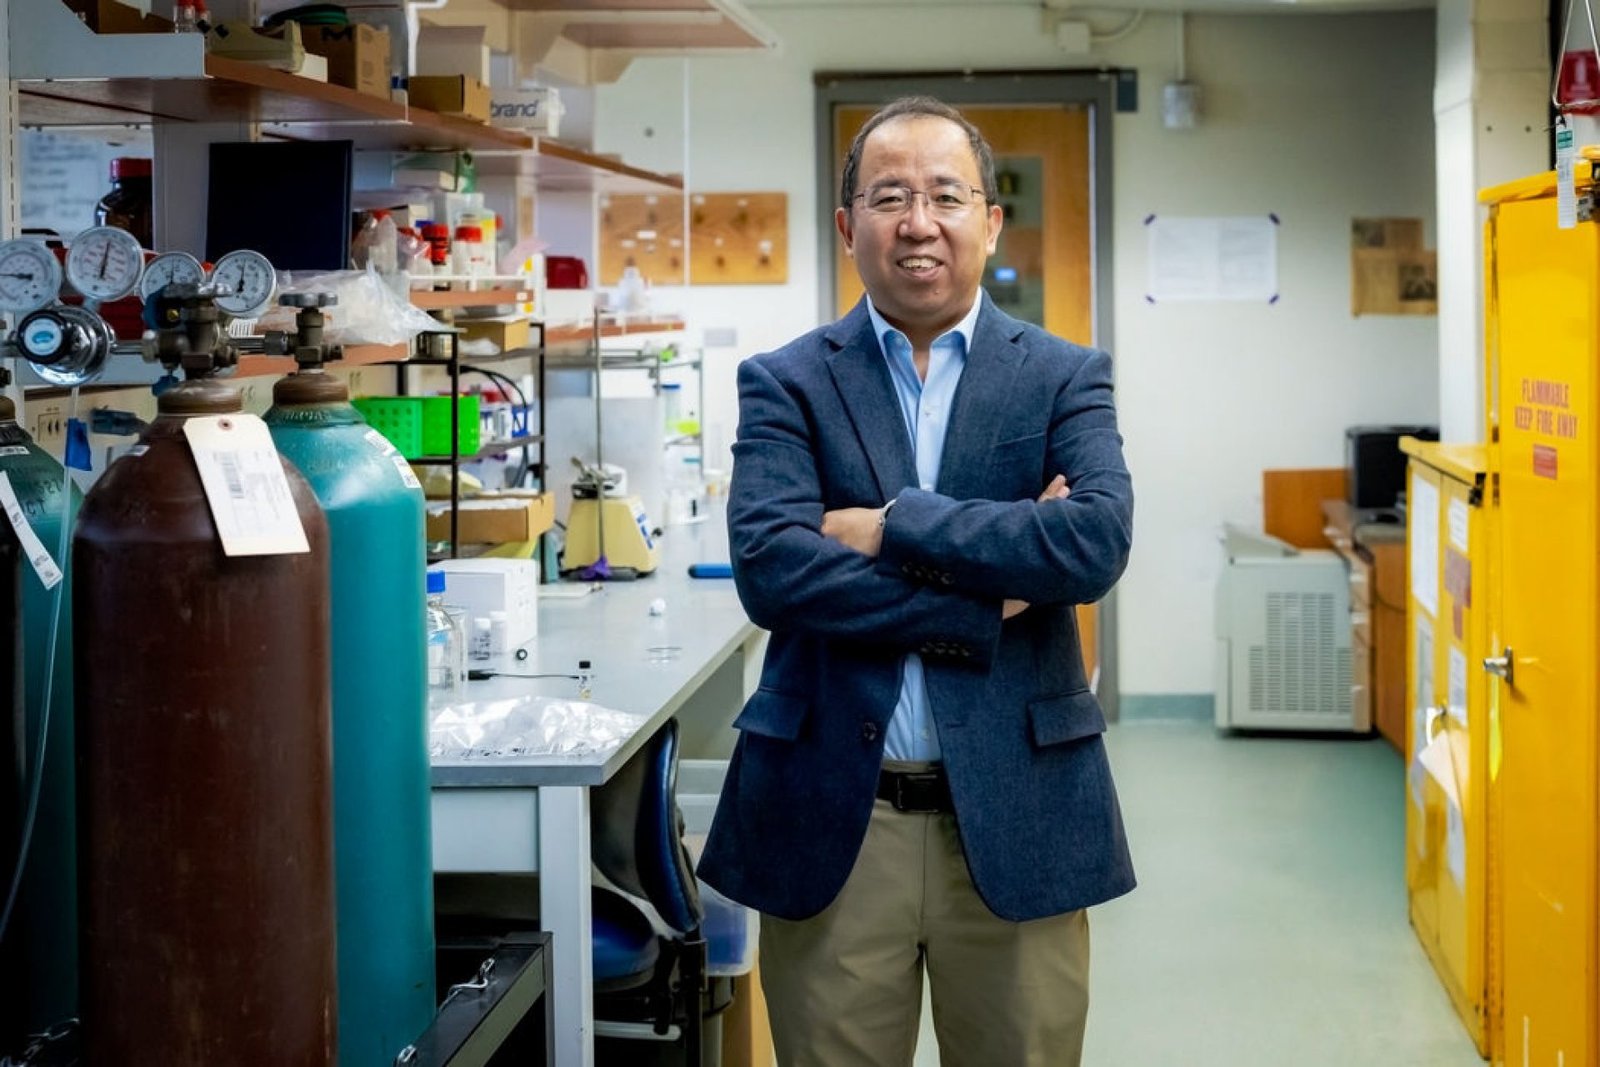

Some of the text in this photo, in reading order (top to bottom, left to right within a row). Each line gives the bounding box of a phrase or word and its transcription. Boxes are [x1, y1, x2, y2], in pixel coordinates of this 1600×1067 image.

[1522, 379, 1569, 408] FLAMMABLE
[1515, 405, 1577, 440] KEEP FIRE AWAY
